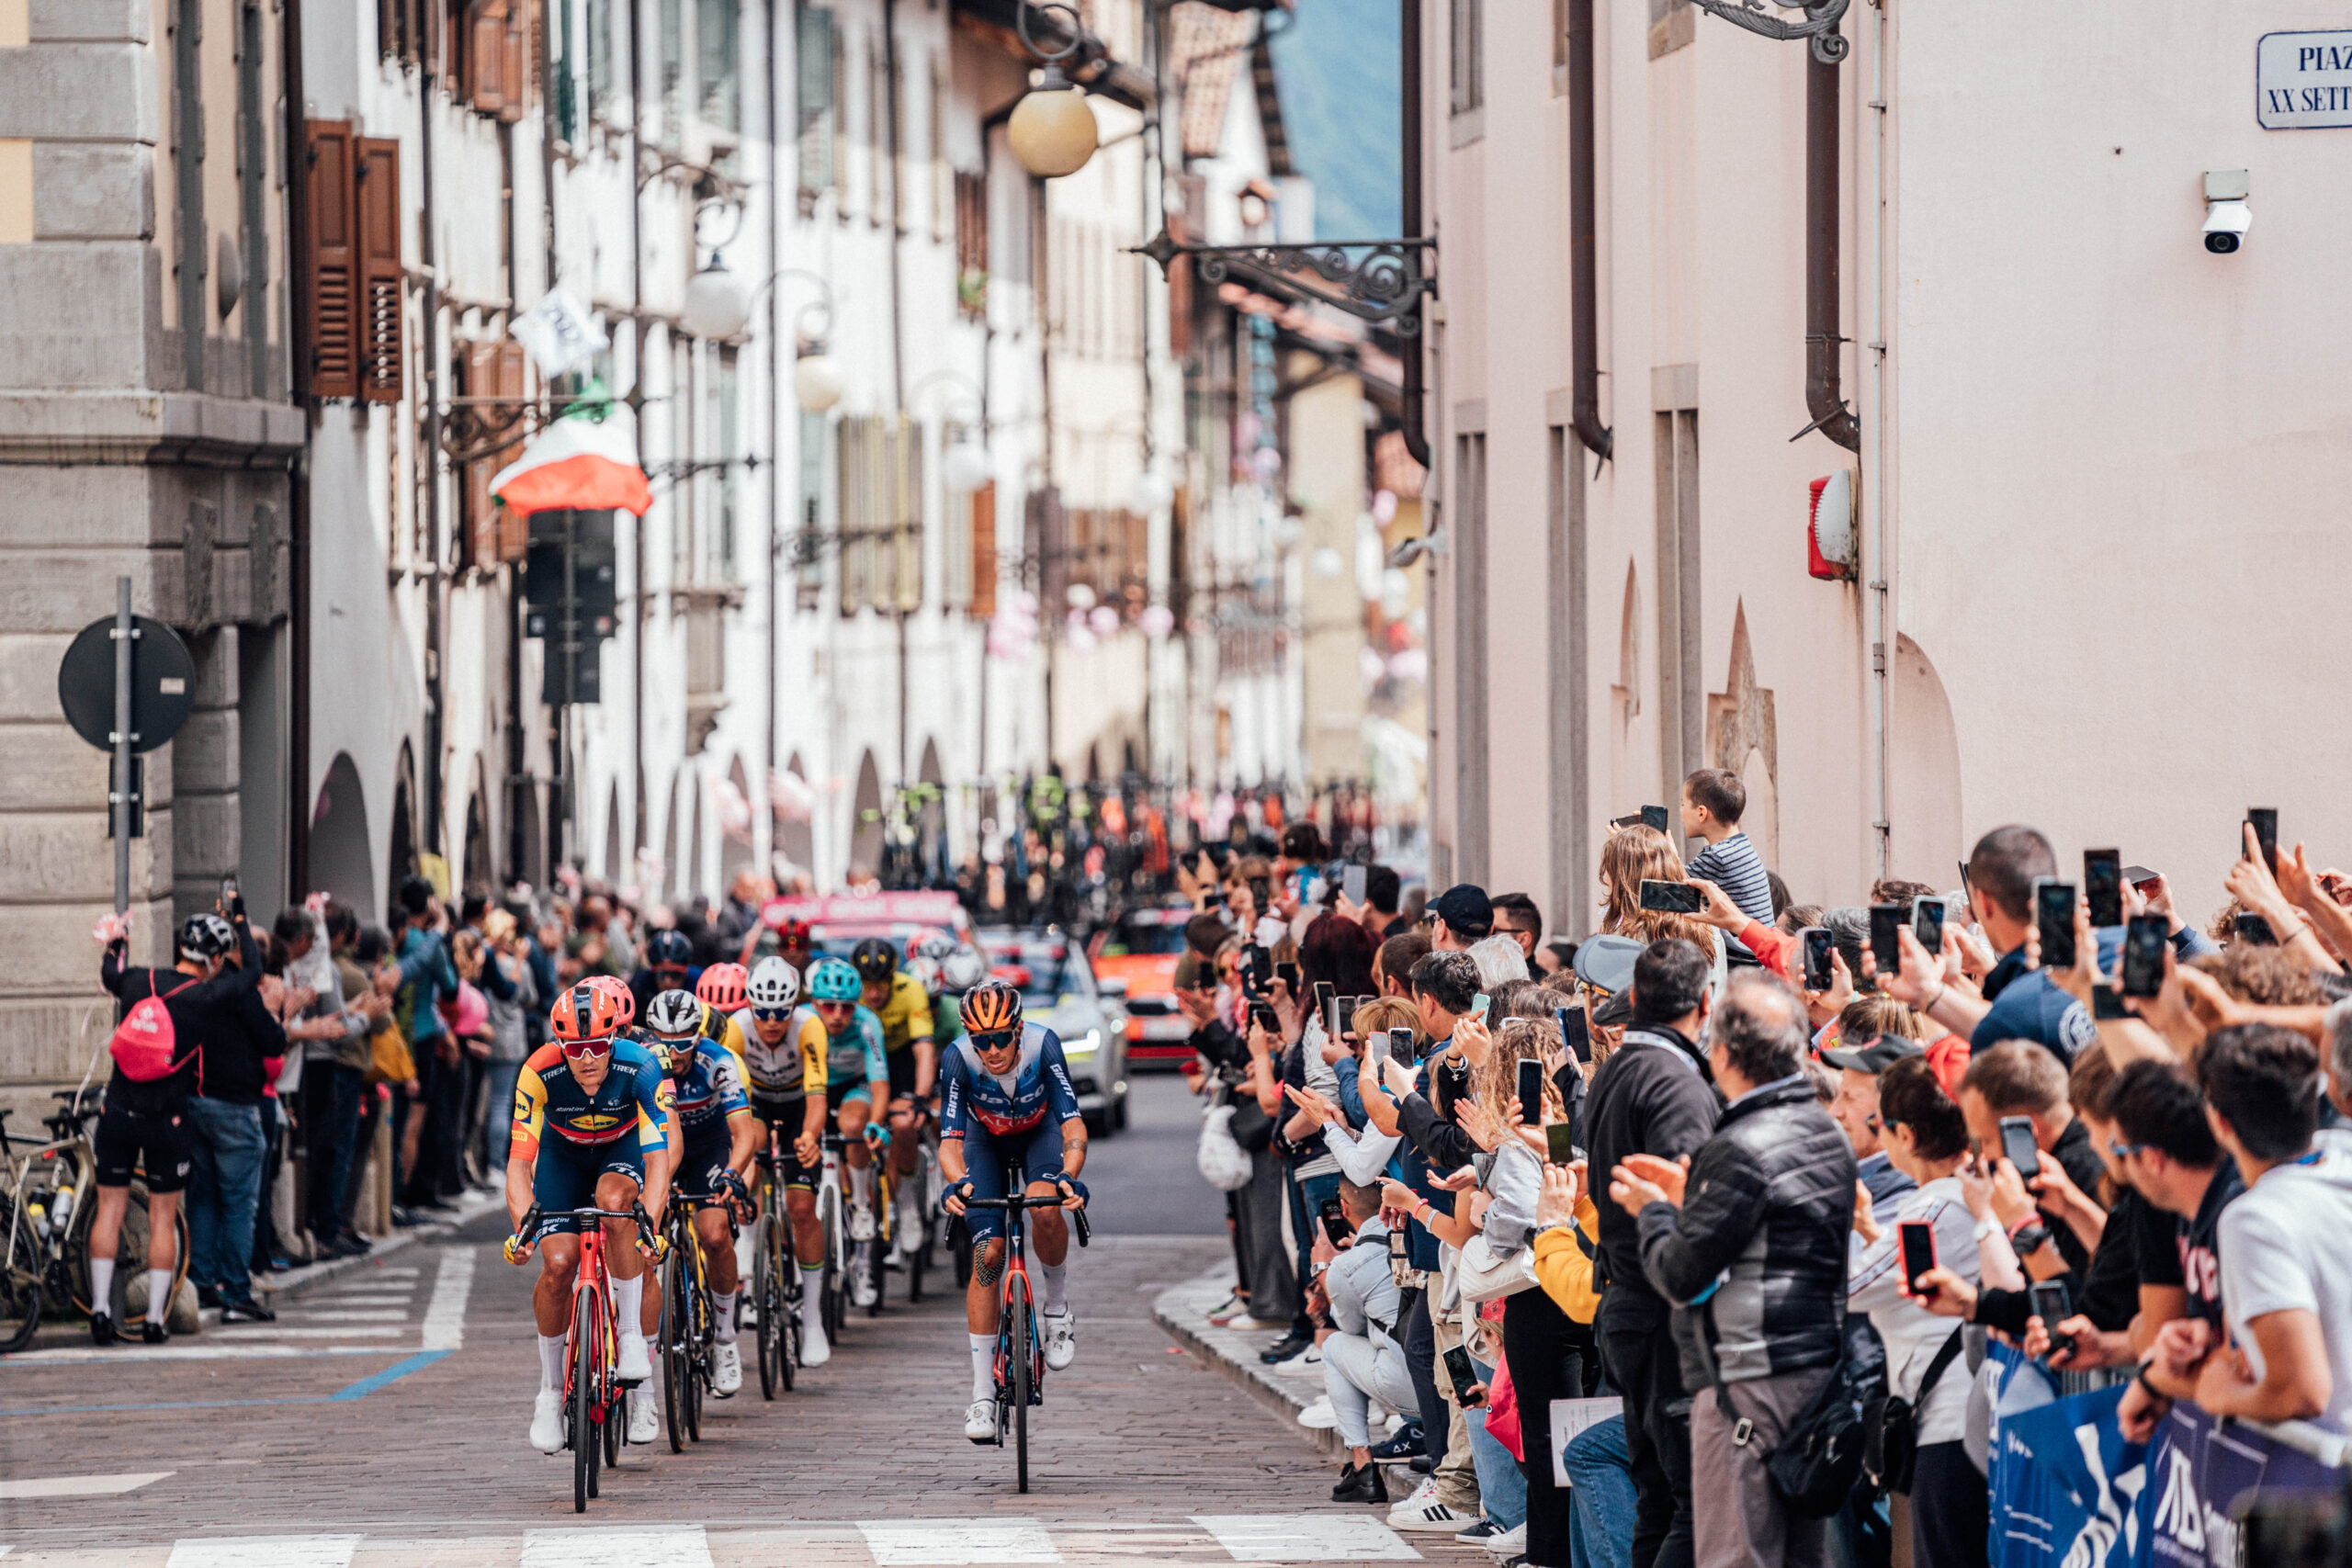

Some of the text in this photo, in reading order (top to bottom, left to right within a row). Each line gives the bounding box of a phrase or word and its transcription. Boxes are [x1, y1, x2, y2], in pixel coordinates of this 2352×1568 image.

[2268, 89, 2295, 113] XX
[541, 1065, 568, 1082] TREK
[612, 1063, 639, 1077] TREK
[1049, 1063, 1076, 1100] GIANT
[946, 1077, 960, 1119] GIANT
